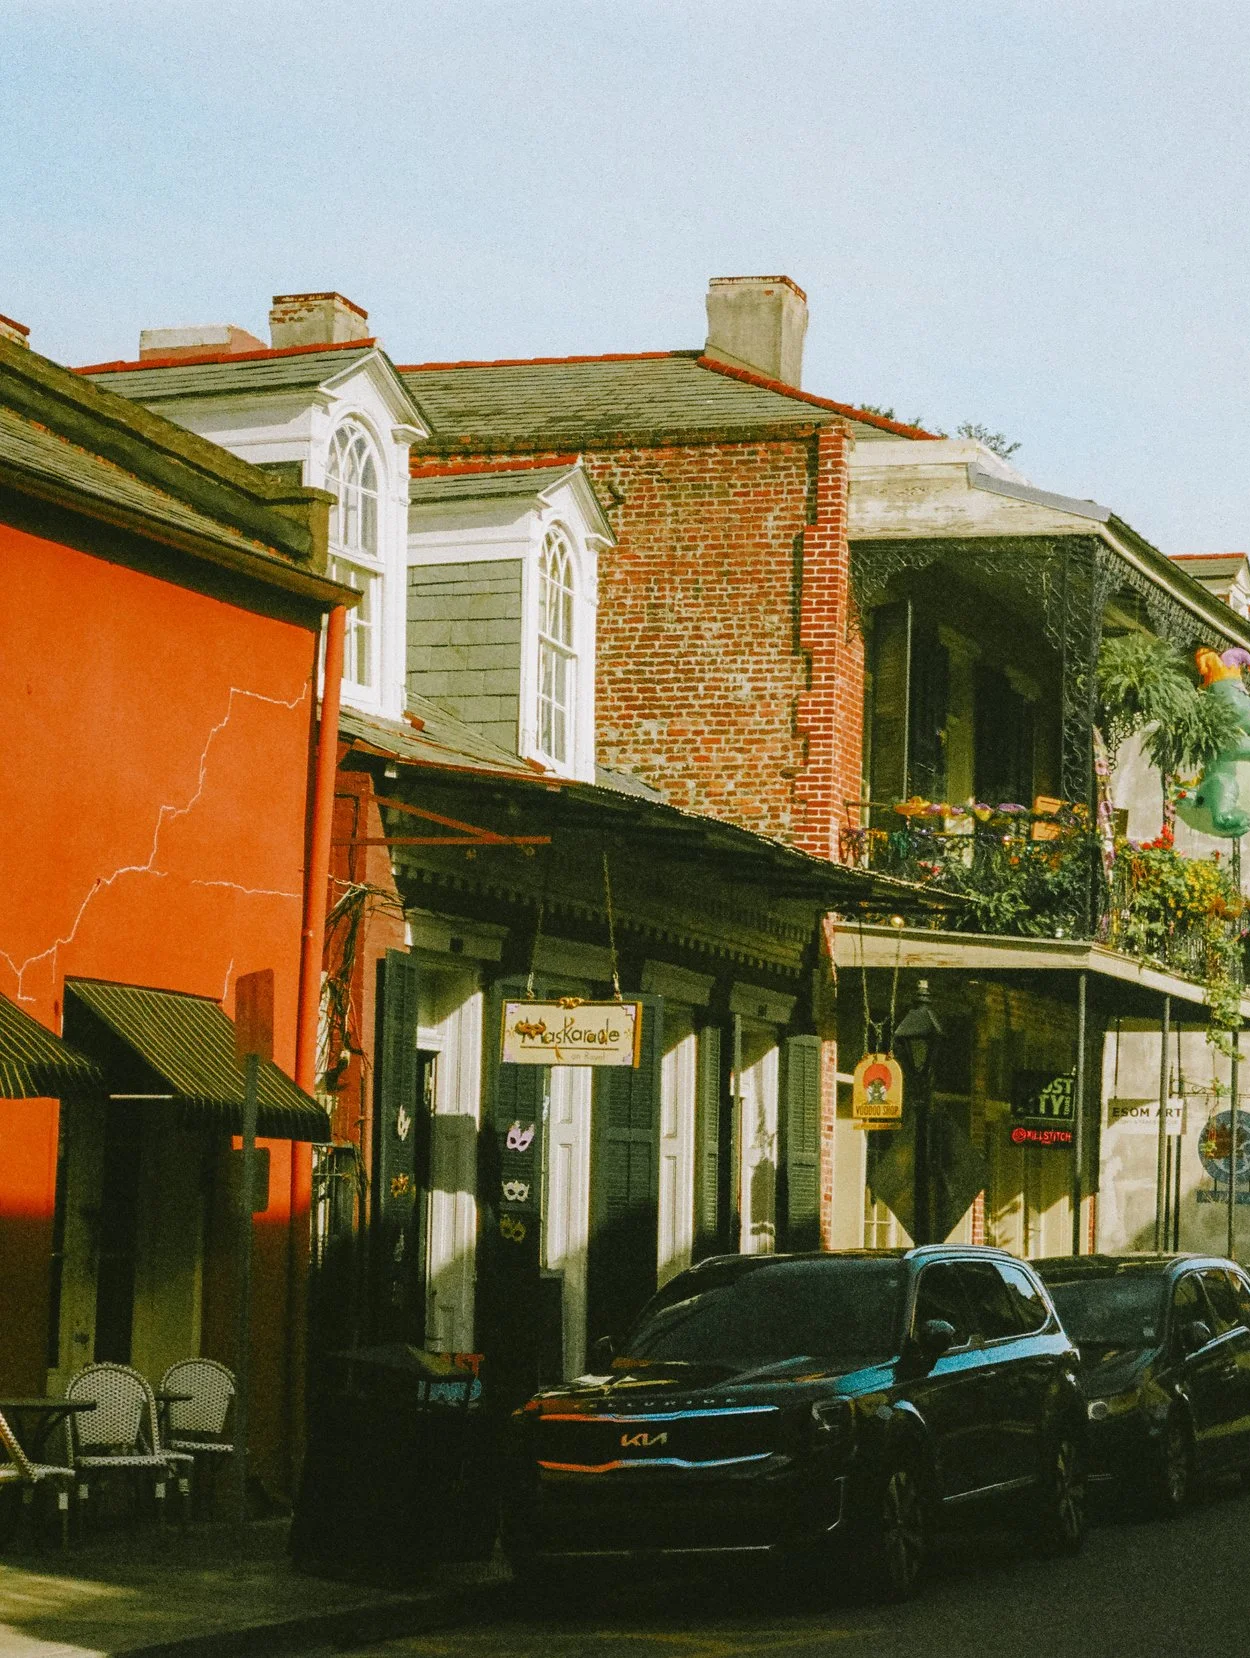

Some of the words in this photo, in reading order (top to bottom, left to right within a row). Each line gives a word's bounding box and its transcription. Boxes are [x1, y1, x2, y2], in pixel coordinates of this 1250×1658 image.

[855, 1105, 881, 1117] VOODOO
[882, 1105, 899, 1117] SHOP
[1112, 1107, 1150, 1118] ESOM
[620, 1432, 668, 1447] KIA
